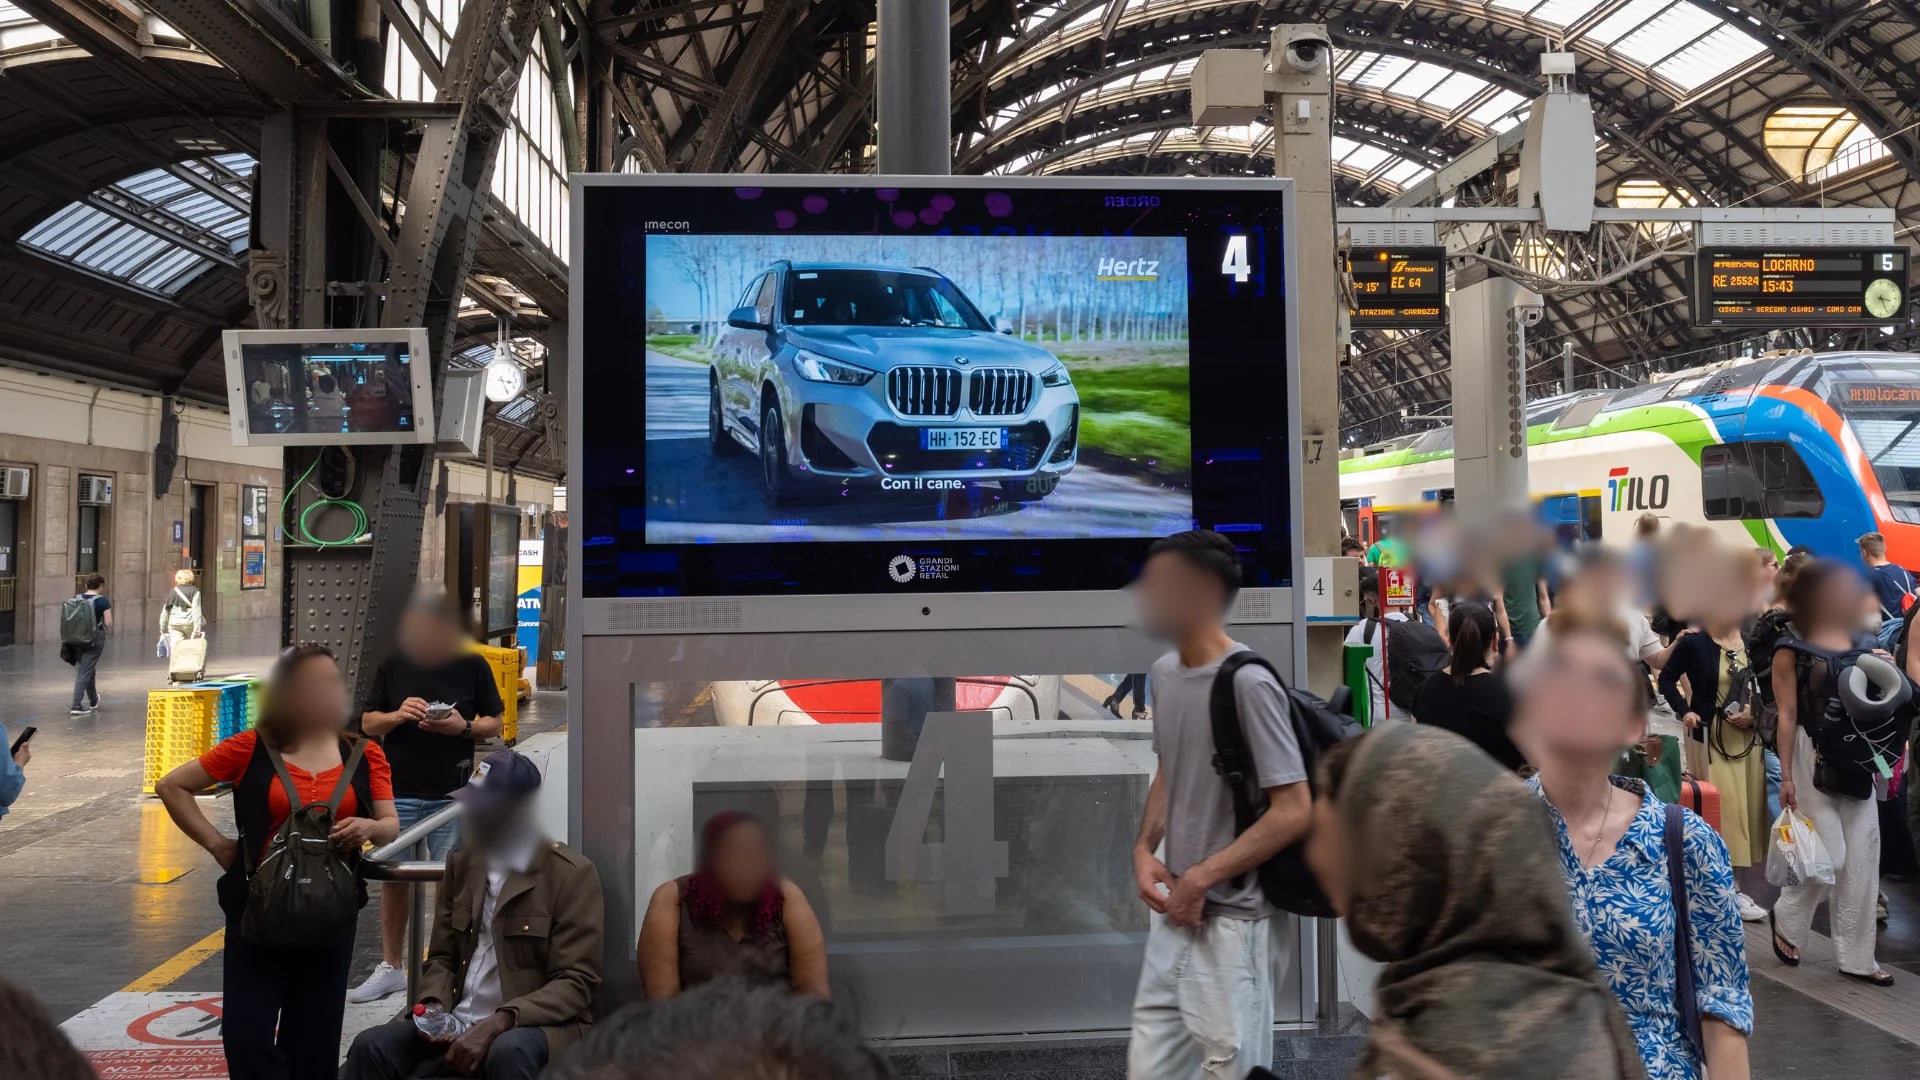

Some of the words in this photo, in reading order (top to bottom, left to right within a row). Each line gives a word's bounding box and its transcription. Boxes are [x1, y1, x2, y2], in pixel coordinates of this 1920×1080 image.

[644, 221, 690, 233] imecon
[1221, 236, 1251, 282] 4
[1882, 254, 1893, 271] 5
[1097, 257, 1160, 276] Hertz
[1762, 259, 1815, 272] LOCARNO
[1366, 282, 1380, 292] 15'
[1391, 276, 1405, 288] EC
[1713, 275, 1728, 287] RE
[1730, 276, 1760, 286] 25524
[1762, 280, 1794, 292] 15:43
[880, 477, 911, 490] Con
[914, 477, 923, 490] il
[926, 480, 966, 490] cane.
[1608, 466, 1670, 512] TILO
[919, 557, 953, 565] GRANDI
[919, 564, 960, 572] STAZIONI
[1312, 577, 1325, 596] 4
[885, 710, 1010, 916] 4
[102, 1065, 142, 1073] NO
[147, 1063, 222, 1072] ENTRY
